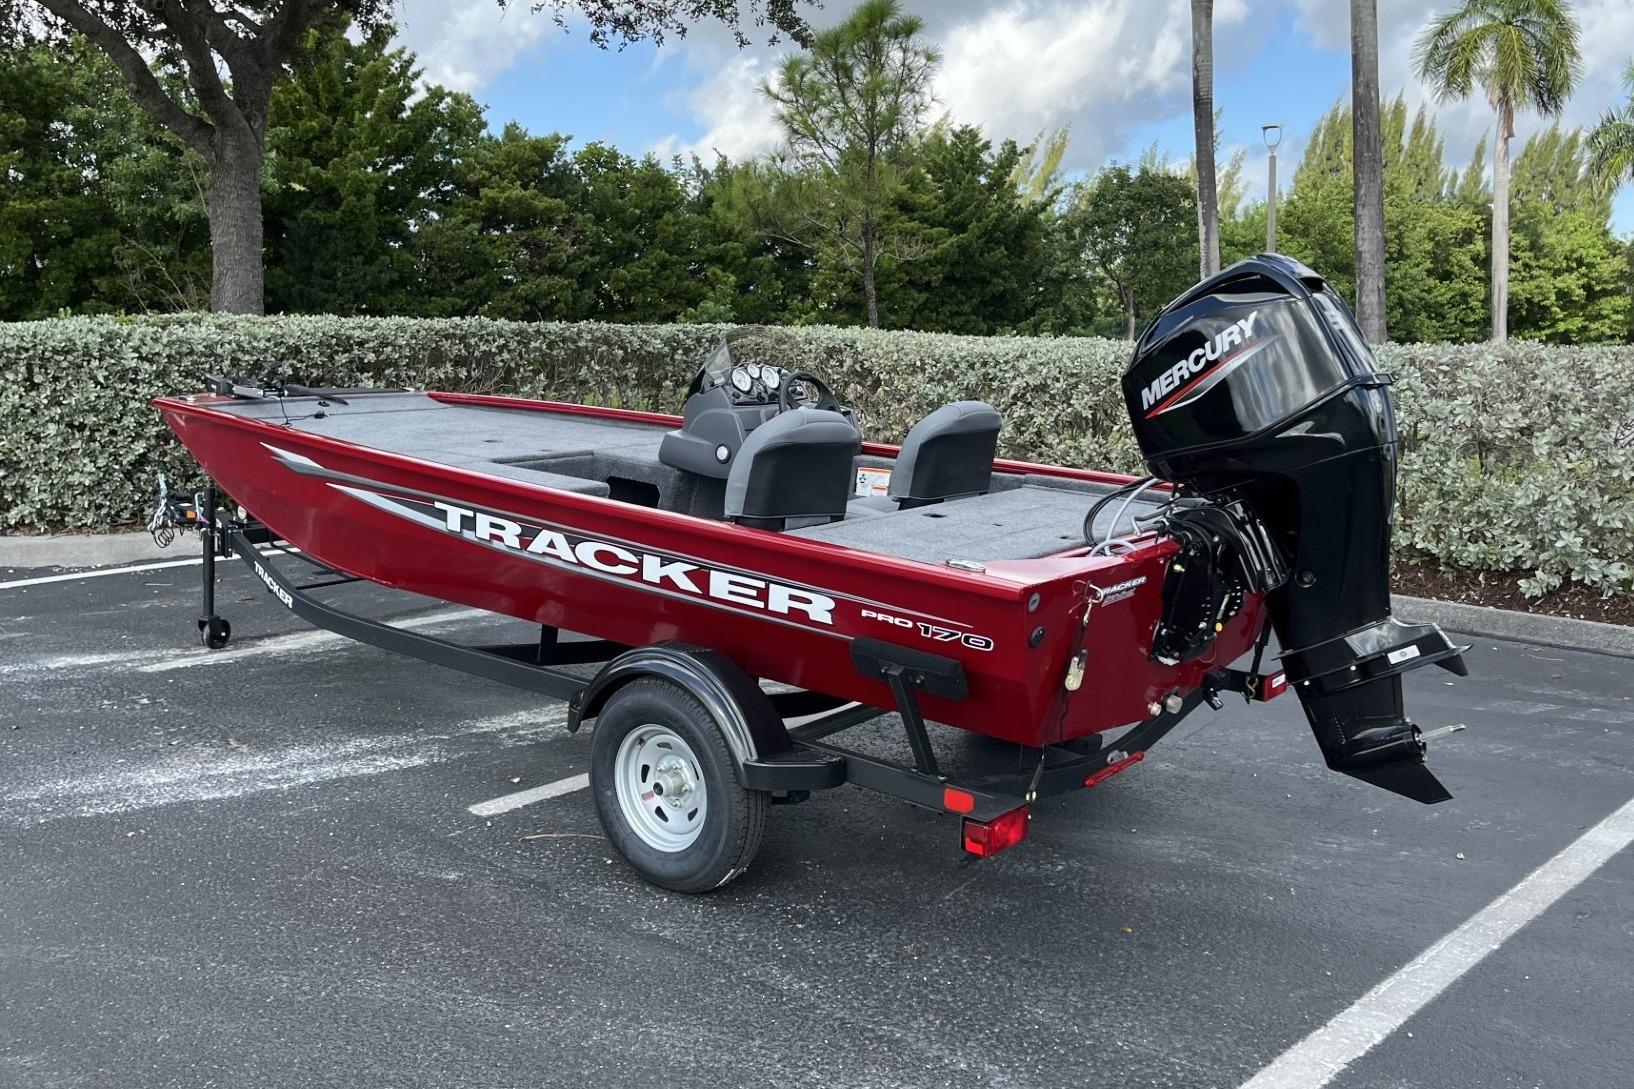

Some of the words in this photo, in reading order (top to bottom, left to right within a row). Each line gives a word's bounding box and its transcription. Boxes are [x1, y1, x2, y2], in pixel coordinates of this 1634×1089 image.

[1141, 310, 1258, 411] MERCURY
[254, 560, 293, 609] TRACKER
[434, 501, 837, 625] TRACKER
[861, 609, 913, 628] PRO
[917, 622, 994, 652] 170
